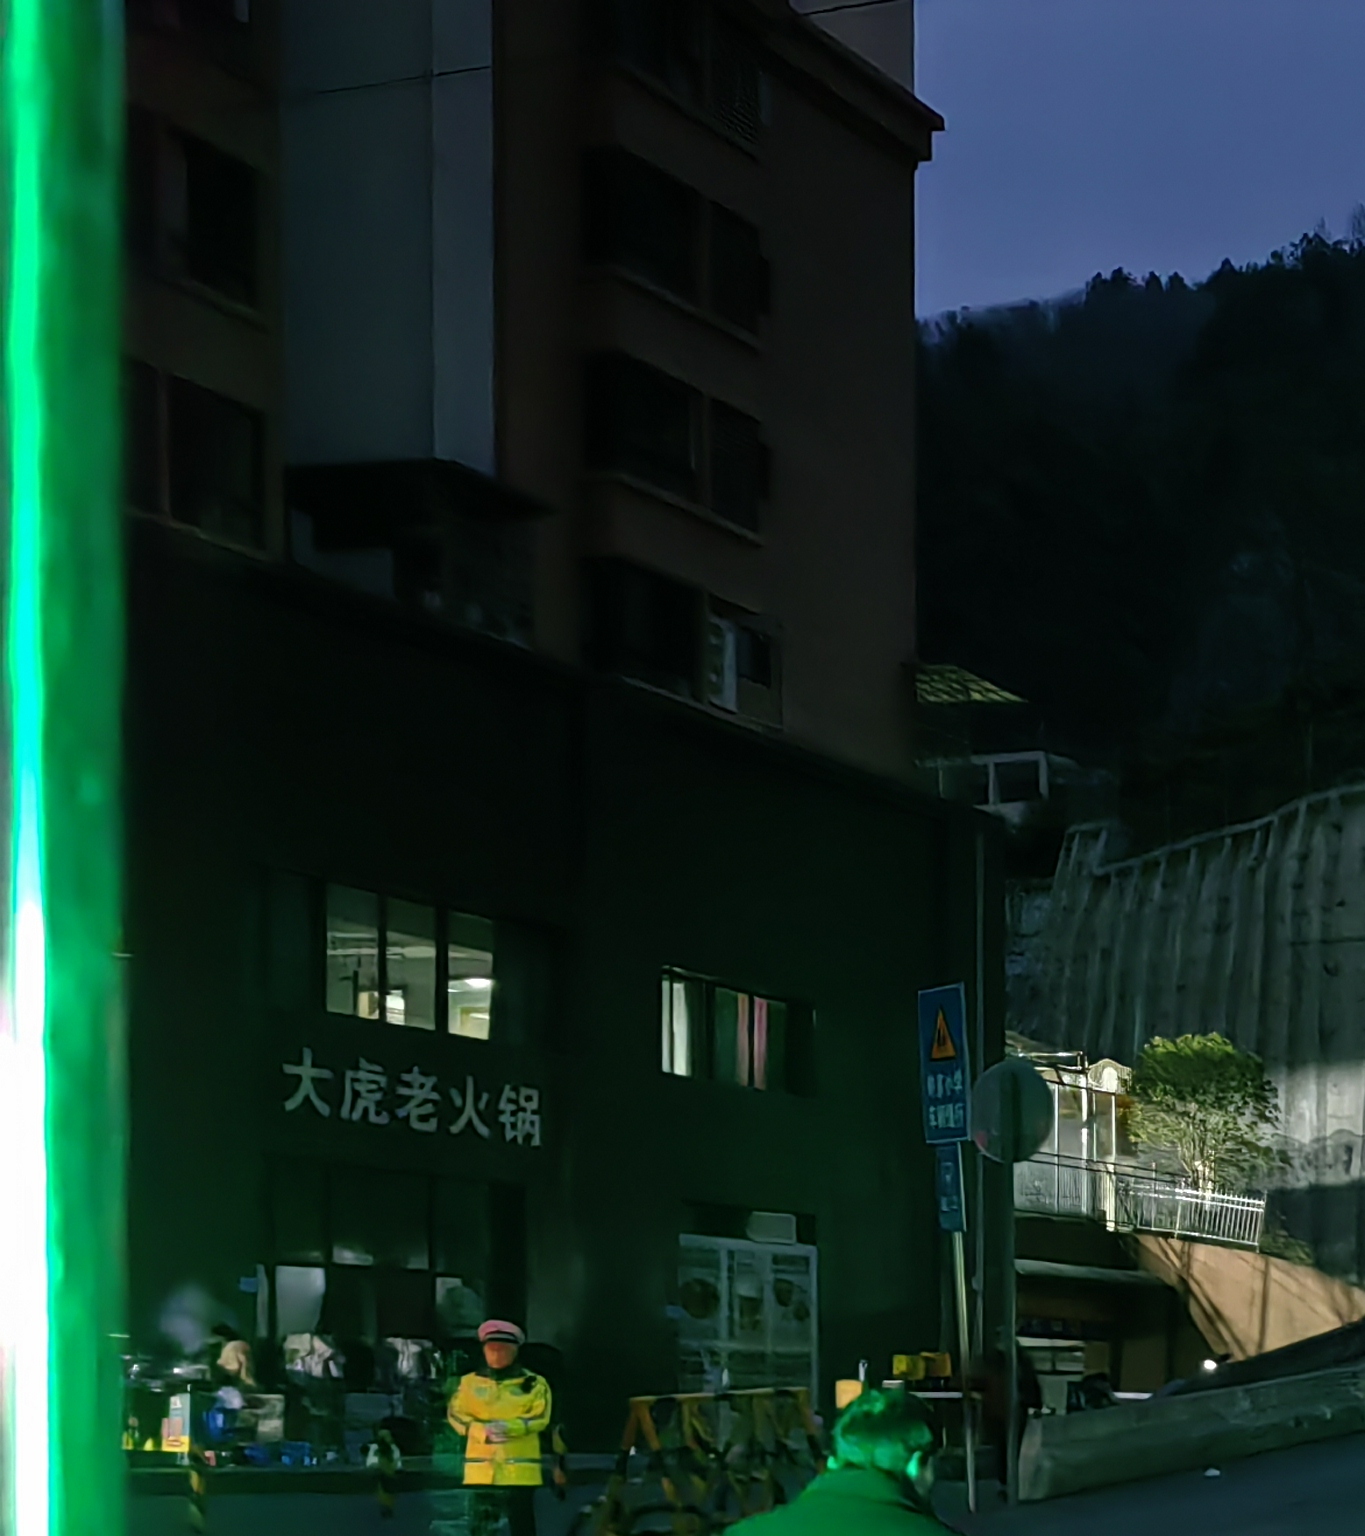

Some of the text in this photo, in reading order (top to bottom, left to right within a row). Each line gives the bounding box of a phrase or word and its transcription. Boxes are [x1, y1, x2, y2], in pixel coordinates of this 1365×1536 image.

[282, 1046, 542, 1147] 大虎老火锅
